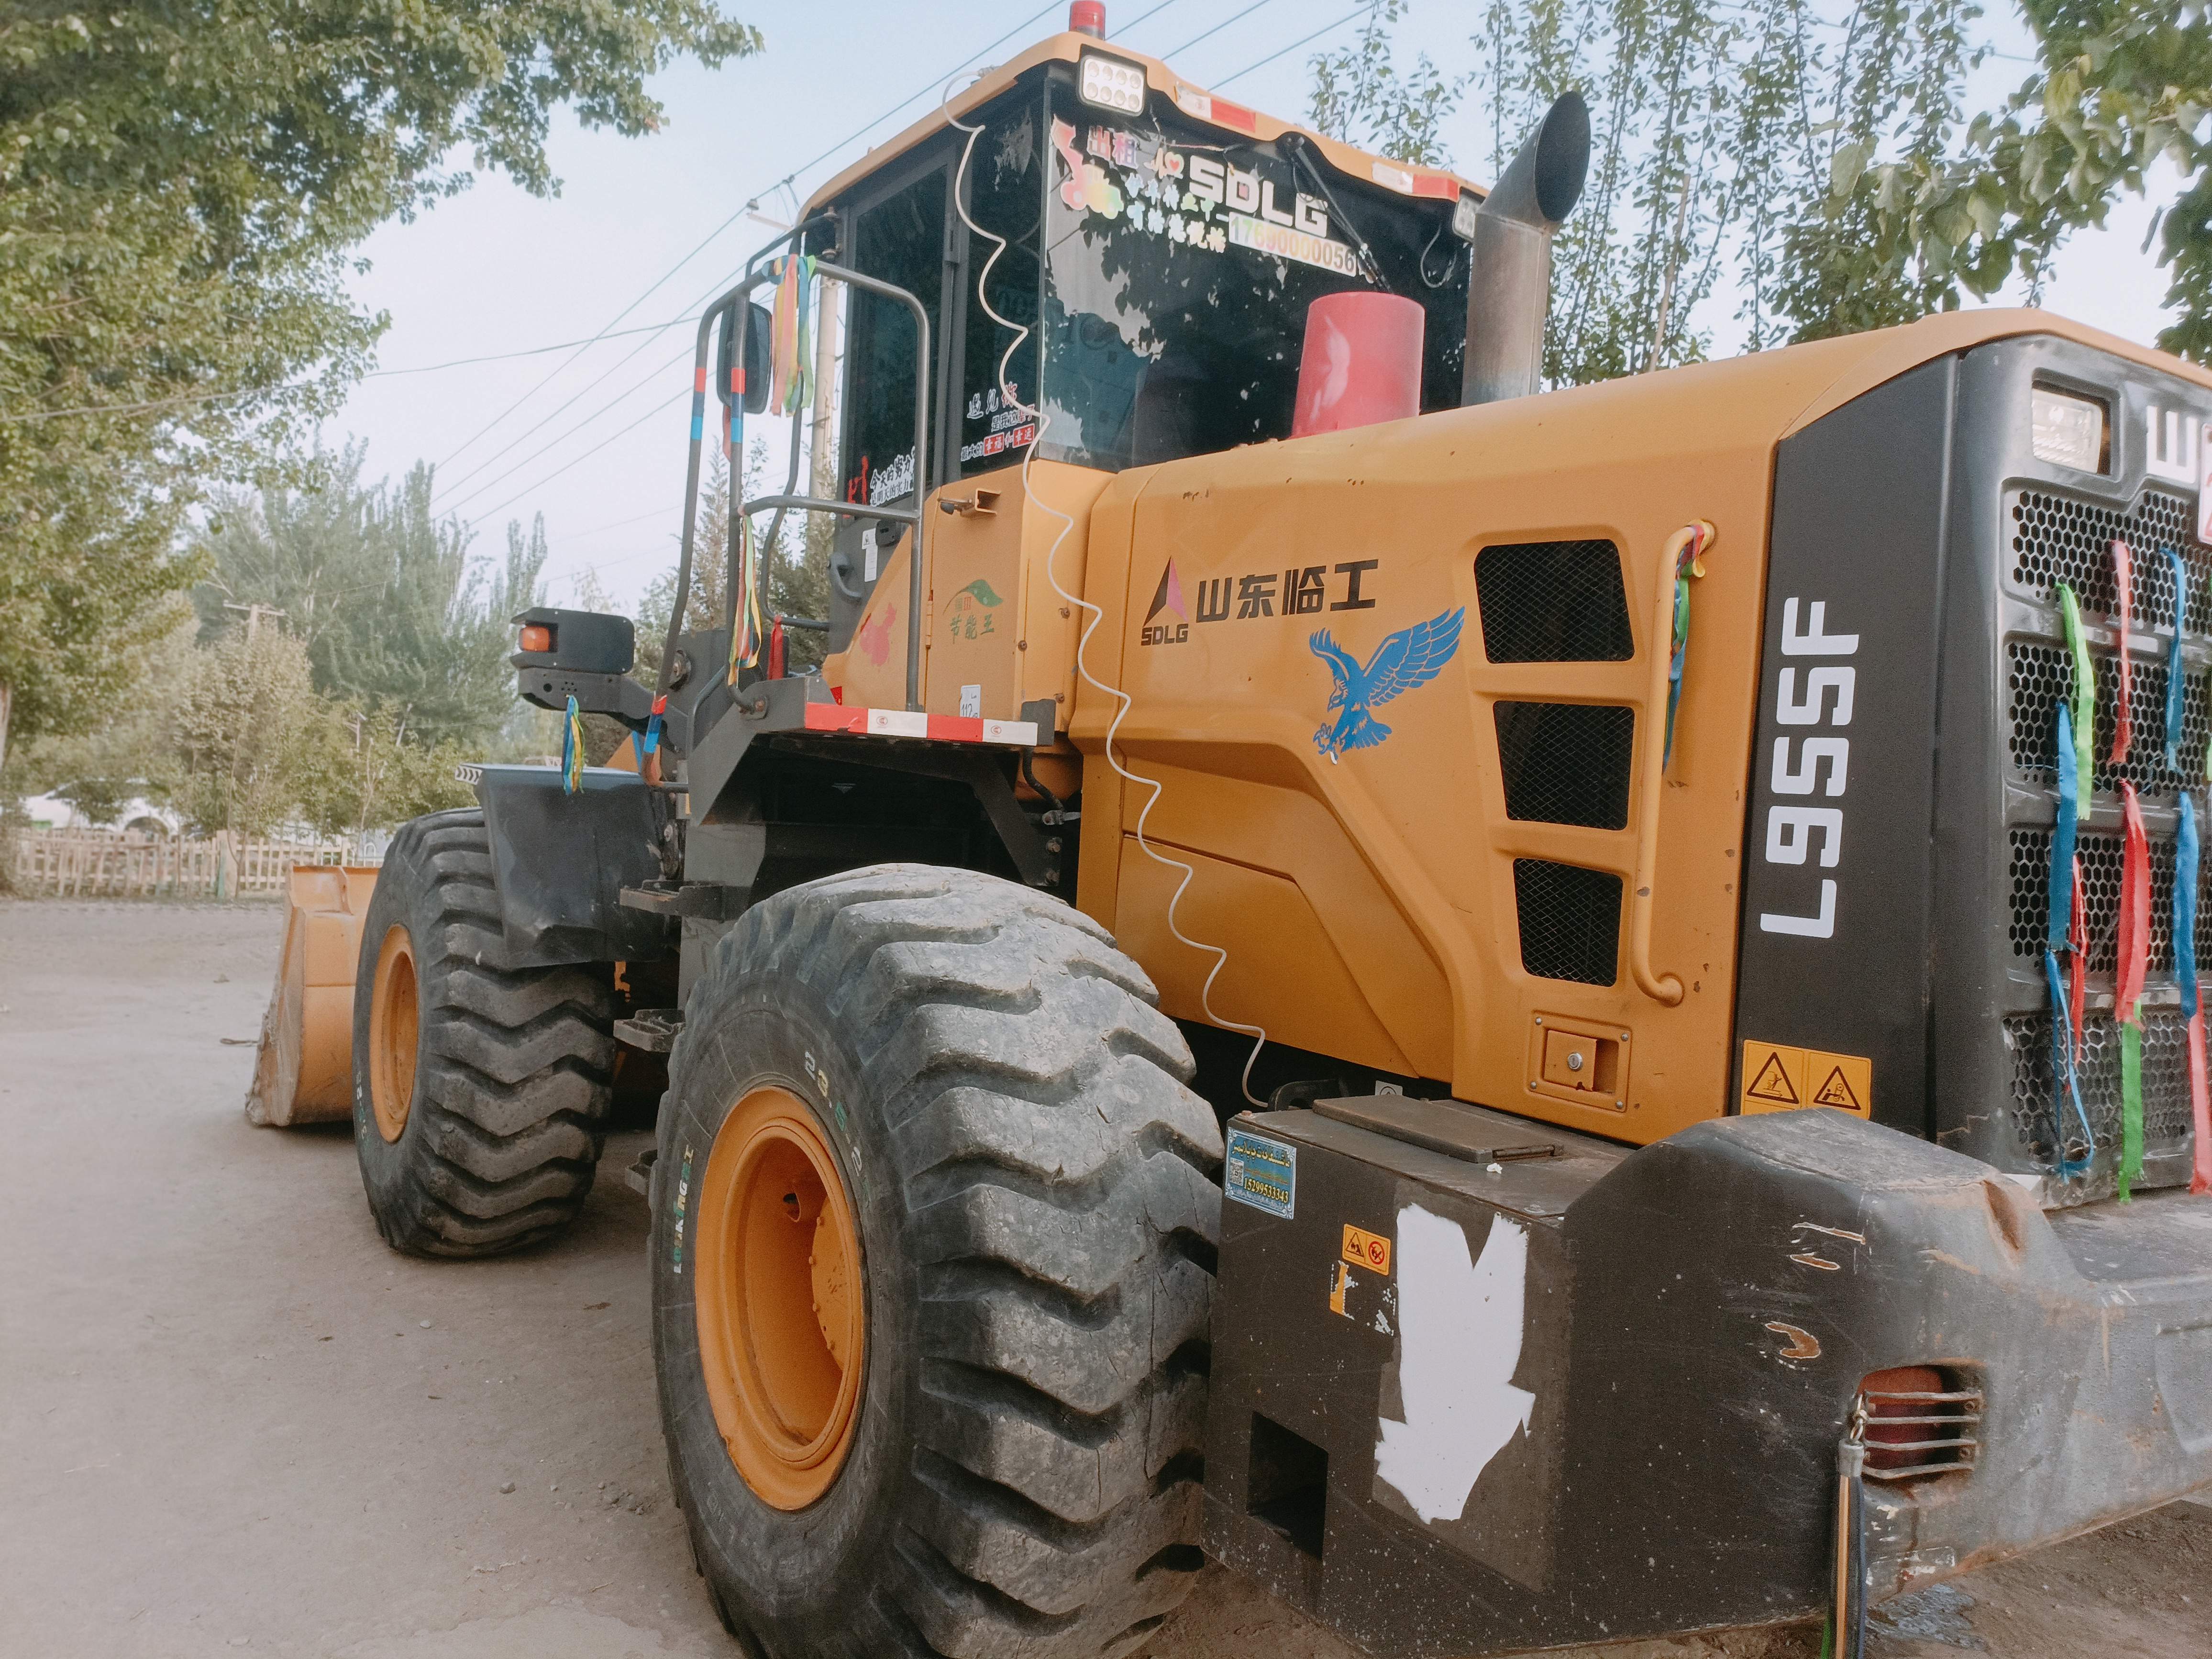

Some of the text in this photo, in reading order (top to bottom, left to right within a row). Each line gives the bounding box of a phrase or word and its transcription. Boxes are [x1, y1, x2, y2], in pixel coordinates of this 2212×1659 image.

[1087, 126, 1138, 169] 出租
[1189, 155, 1328, 237] SDLG
[961, 424, 1034, 461] 最大的幸福和幸运
[1196, 559, 1379, 622] 山东临工
[949, 613, 995, 644] 节能王
[1141, 623, 1189, 646] SDLG
[1760, 597, 1859, 938] L955F
[1244, 1177, 1289, 1203] 15299533343
